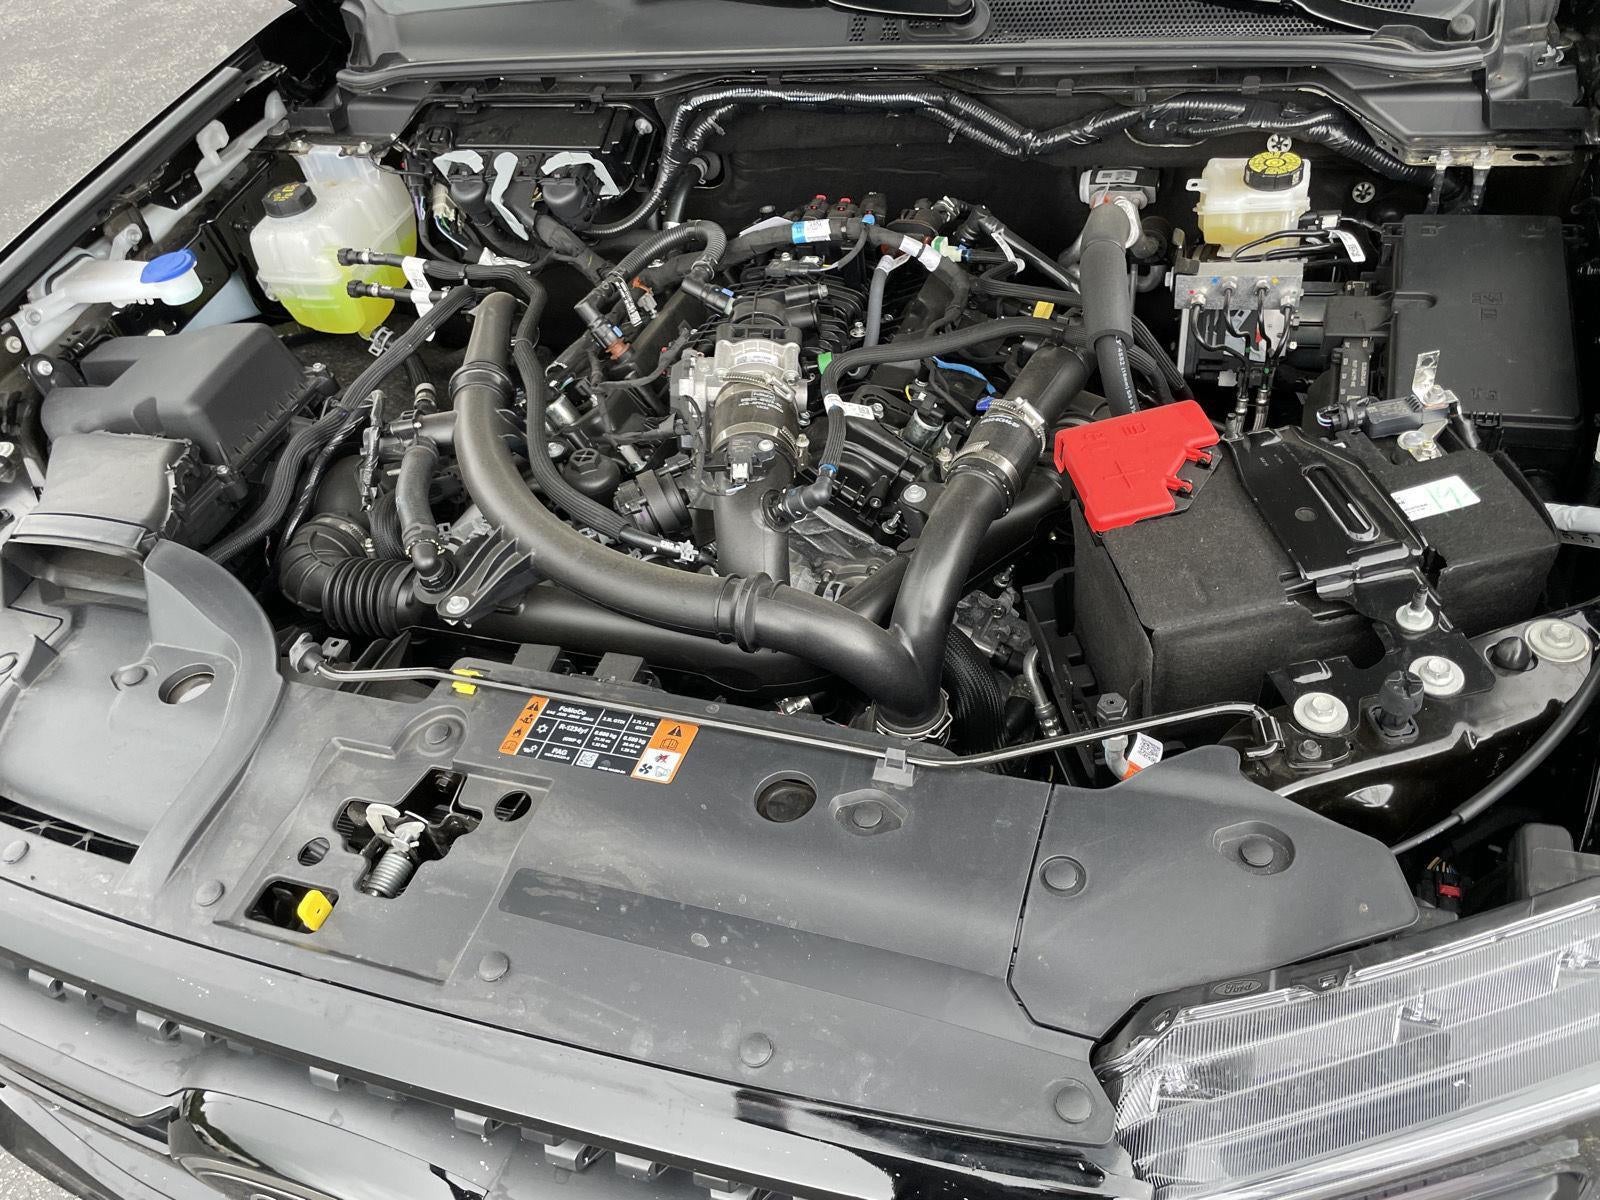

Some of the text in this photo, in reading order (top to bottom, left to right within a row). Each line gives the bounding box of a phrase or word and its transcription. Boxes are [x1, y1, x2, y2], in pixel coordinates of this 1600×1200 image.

[558, 705, 587, 716] FoMoCo
[558, 723, 589, 735] R-1234yf
[551, 747, 568, 756] PAG
[1223, 982, 1252, 993] Ford
